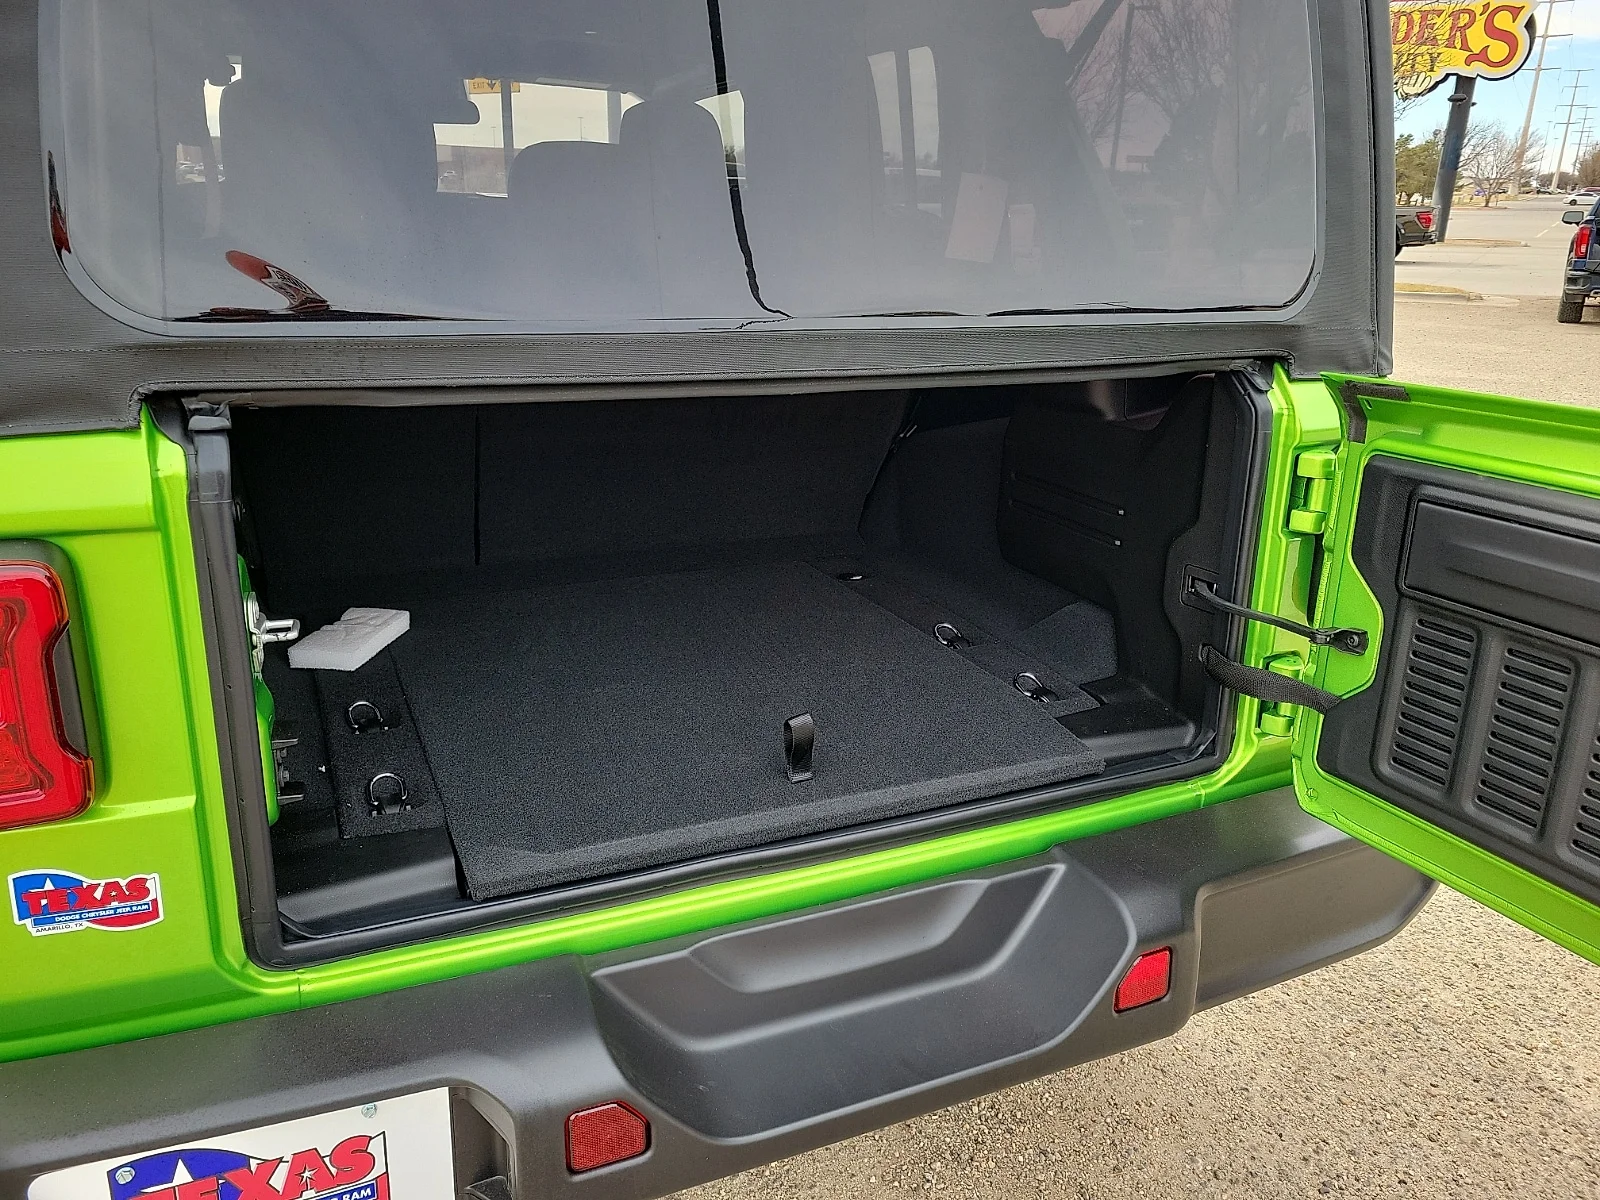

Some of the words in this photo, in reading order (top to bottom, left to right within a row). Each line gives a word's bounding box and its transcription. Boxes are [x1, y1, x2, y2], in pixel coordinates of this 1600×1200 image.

[22, 877, 151, 915] TEXAS
[55, 914, 80, 922] DODGE
[81, 909, 115, 919] CHRYSLER
[342, 1187, 372, 1200] RAM
